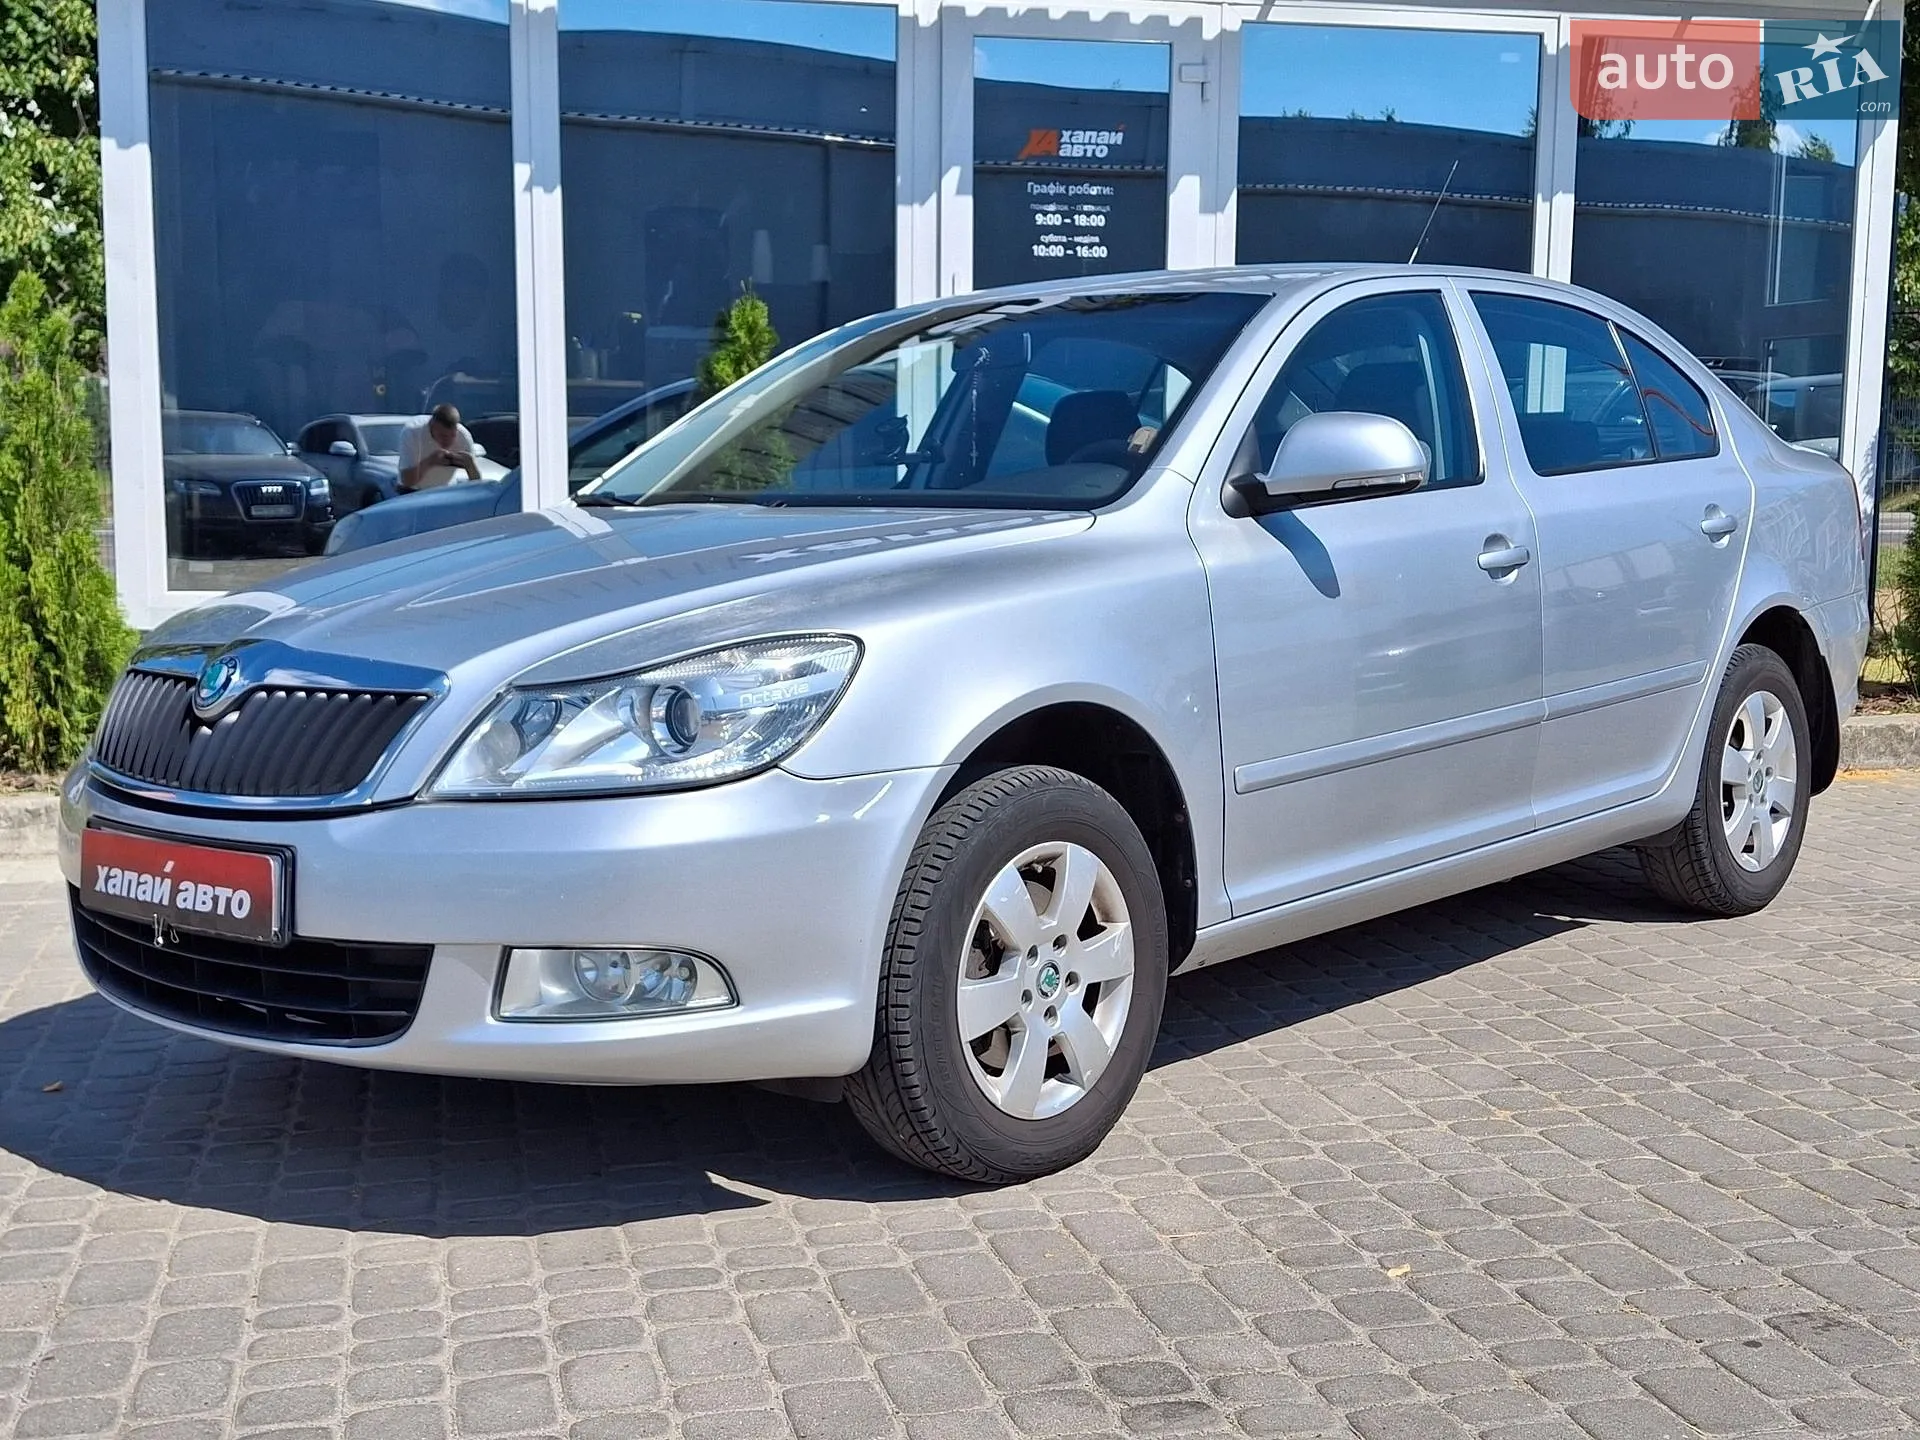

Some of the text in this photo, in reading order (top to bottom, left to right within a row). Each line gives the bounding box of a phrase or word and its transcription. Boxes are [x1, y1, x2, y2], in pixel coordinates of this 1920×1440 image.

[1058, 144, 1108, 158] авто
[1027, 182, 1115, 196] Графік роботи:
[1034, 213, 1062, 226] 9:00
[1073, 214, 1106, 227] 18:00
[1032, 244, 1065, 257] 10:00
[1075, 245, 1108, 258] 16:00
[94, 860, 251, 919] хапай авто
